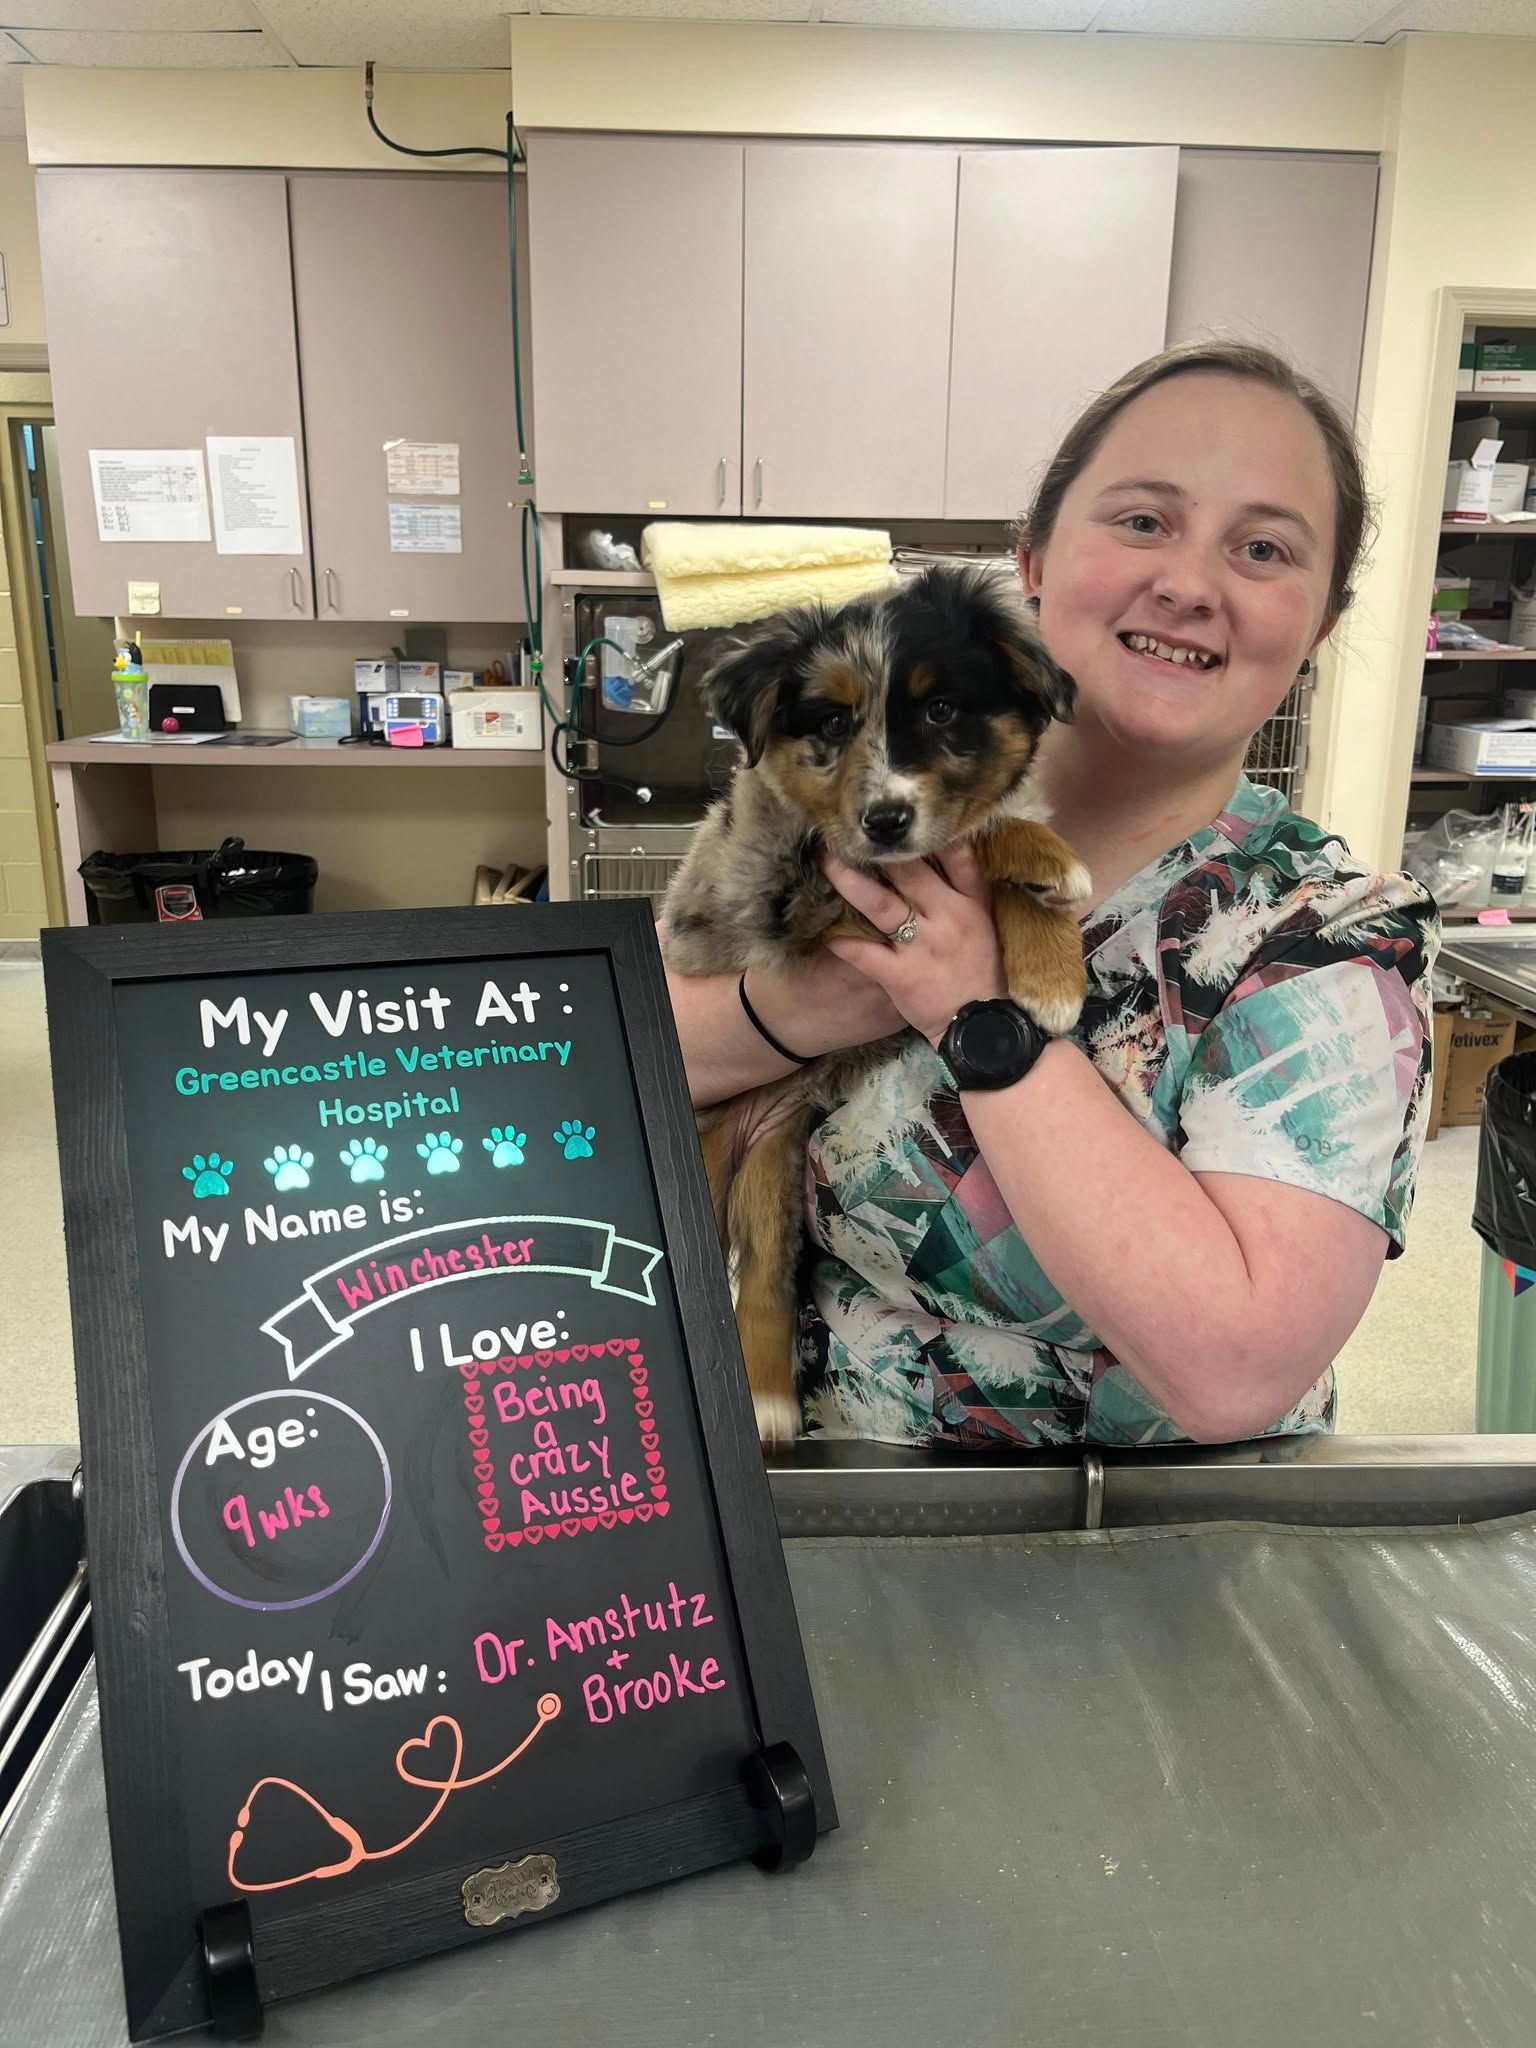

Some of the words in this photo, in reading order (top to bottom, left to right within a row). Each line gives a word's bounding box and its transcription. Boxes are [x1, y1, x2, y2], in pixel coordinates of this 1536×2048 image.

[199, 996, 289, 1057] My
[309, 986, 452, 1038] Visit
[175, 1051, 387, 1096] Greencastle
[394, 1039, 572, 1073] Veterinary
[318, 1087, 460, 1128] Hospital
[162, 1215, 230, 1263] My
[244, 1204, 368, 1246] Name
[378, 1189, 425, 1225] is:
[336, 1234, 535, 1310] Winchester
[409, 1327, 425, 1373] I
[439, 1310, 571, 1368] Love:
[493, 1375, 606, 1425] Being
[204, 1407, 319, 1469] Age:
[510, 1436, 611, 1486] crazy
[533, 1421, 558, 1450] a
[520, 1471, 646, 1524] Aussie
[474, 1631, 537, 1684] Dr.
[545, 1582, 713, 1661] Amstutz
[177, 1648, 314, 1702] Today
[320, 1669, 334, 1712] I
[582, 1653, 726, 1723] Brooke
